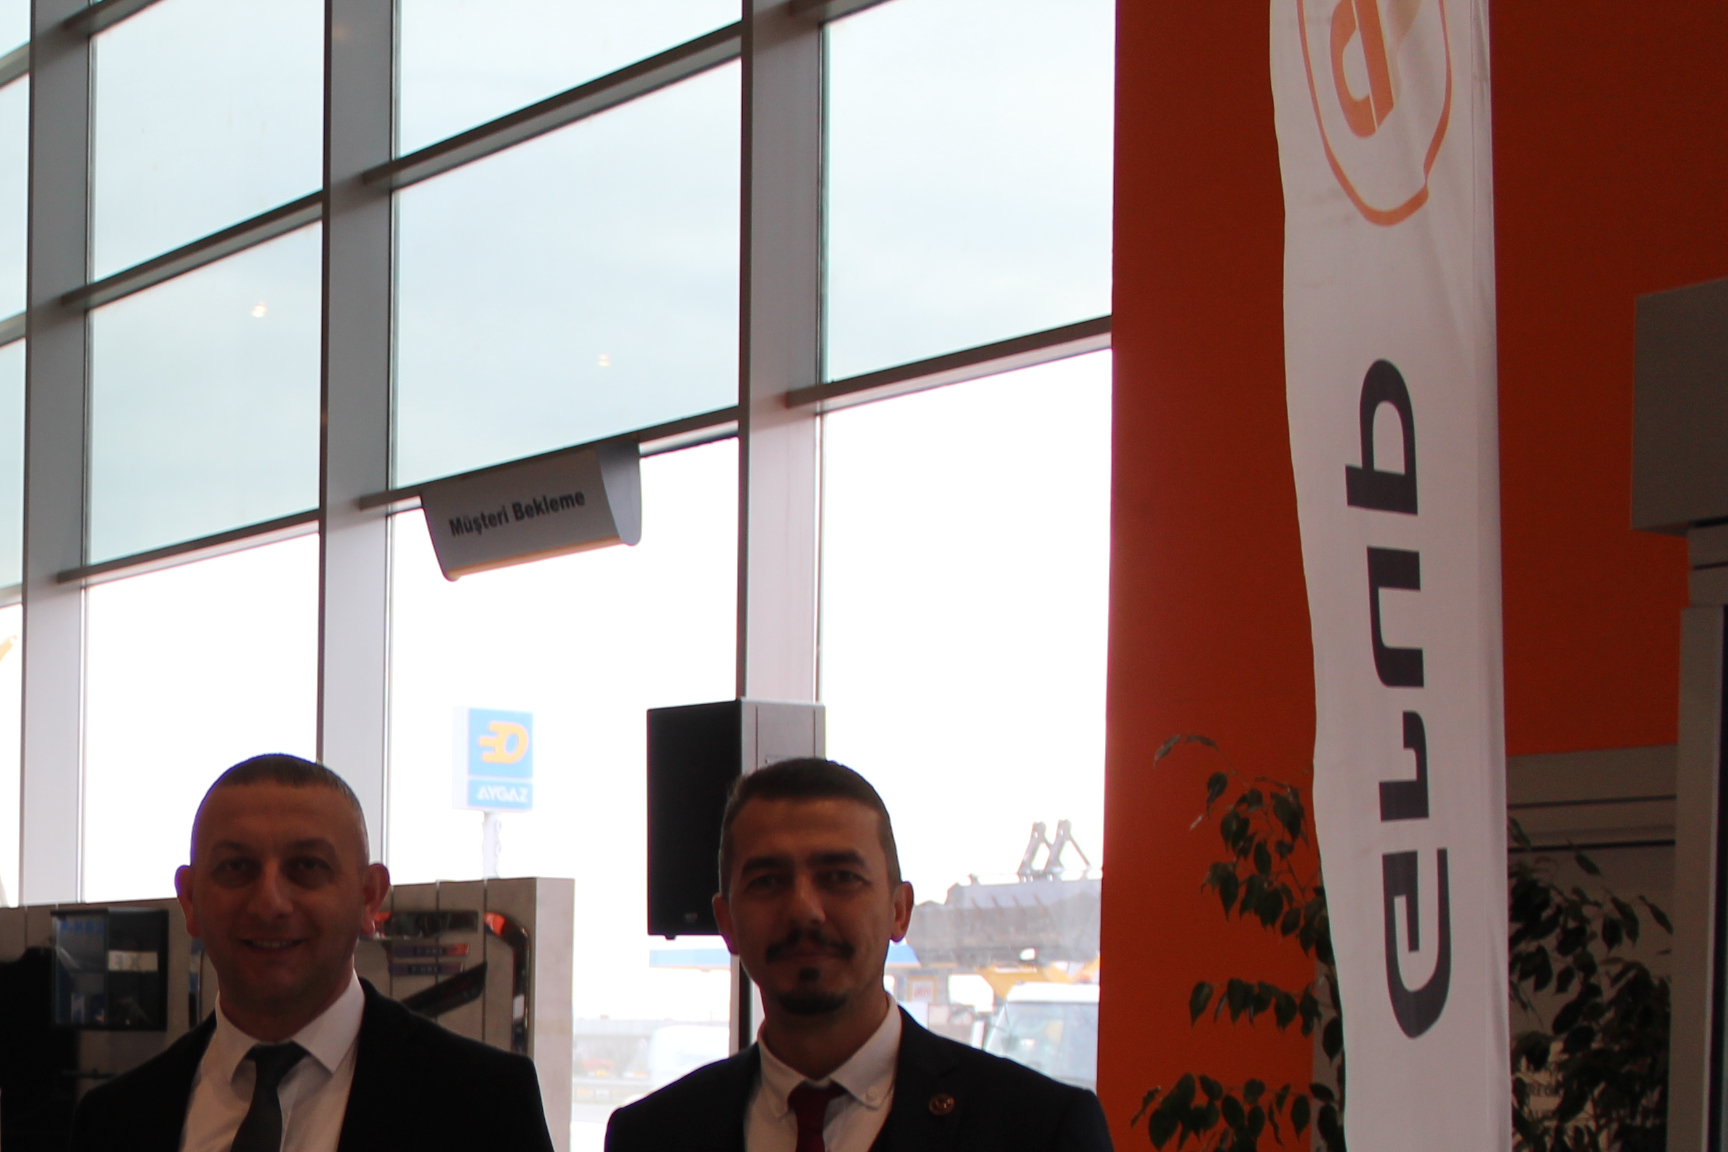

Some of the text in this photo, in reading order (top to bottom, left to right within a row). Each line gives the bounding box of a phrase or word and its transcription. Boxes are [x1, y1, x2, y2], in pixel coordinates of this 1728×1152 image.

[448, 490, 586, 537] Müşteri Bekleme
[477, 785, 529, 804] AYGAZ
